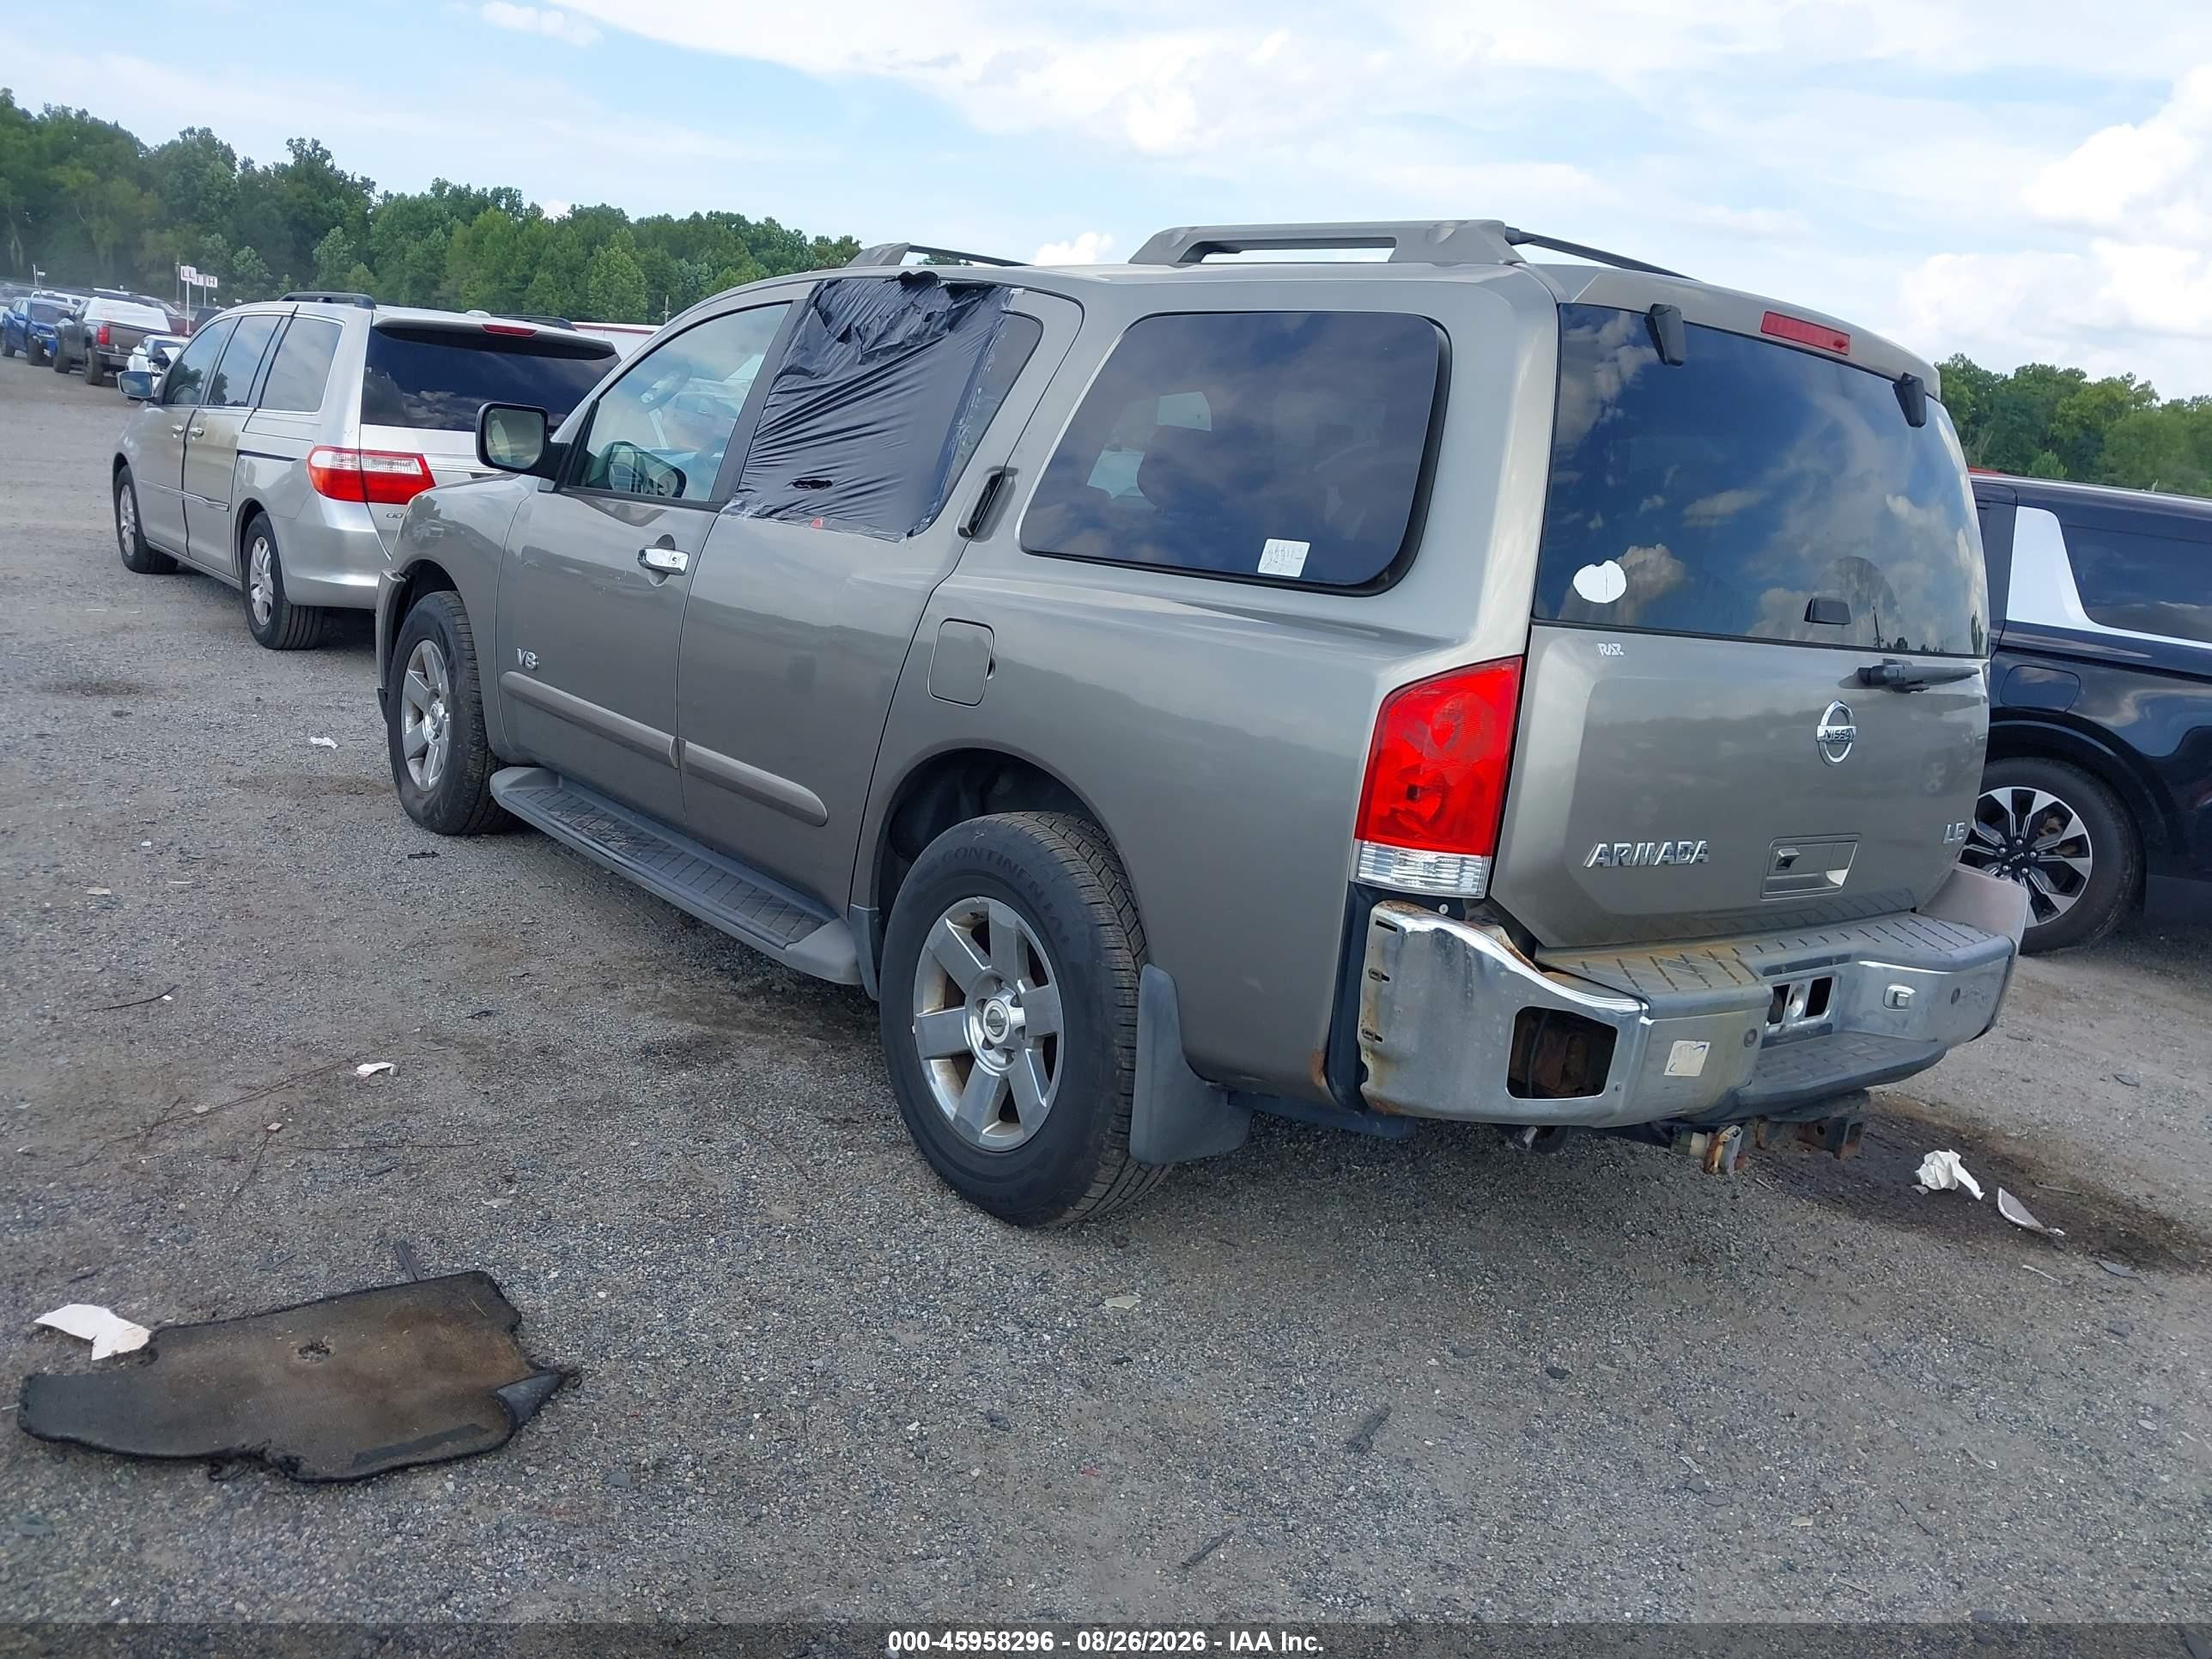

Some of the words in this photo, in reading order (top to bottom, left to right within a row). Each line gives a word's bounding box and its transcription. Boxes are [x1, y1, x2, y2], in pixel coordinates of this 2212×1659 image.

[516, 647, 539, 670] V8
[1942, 822, 1966, 844] LE
[1583, 840, 1710, 868] ARMADA
